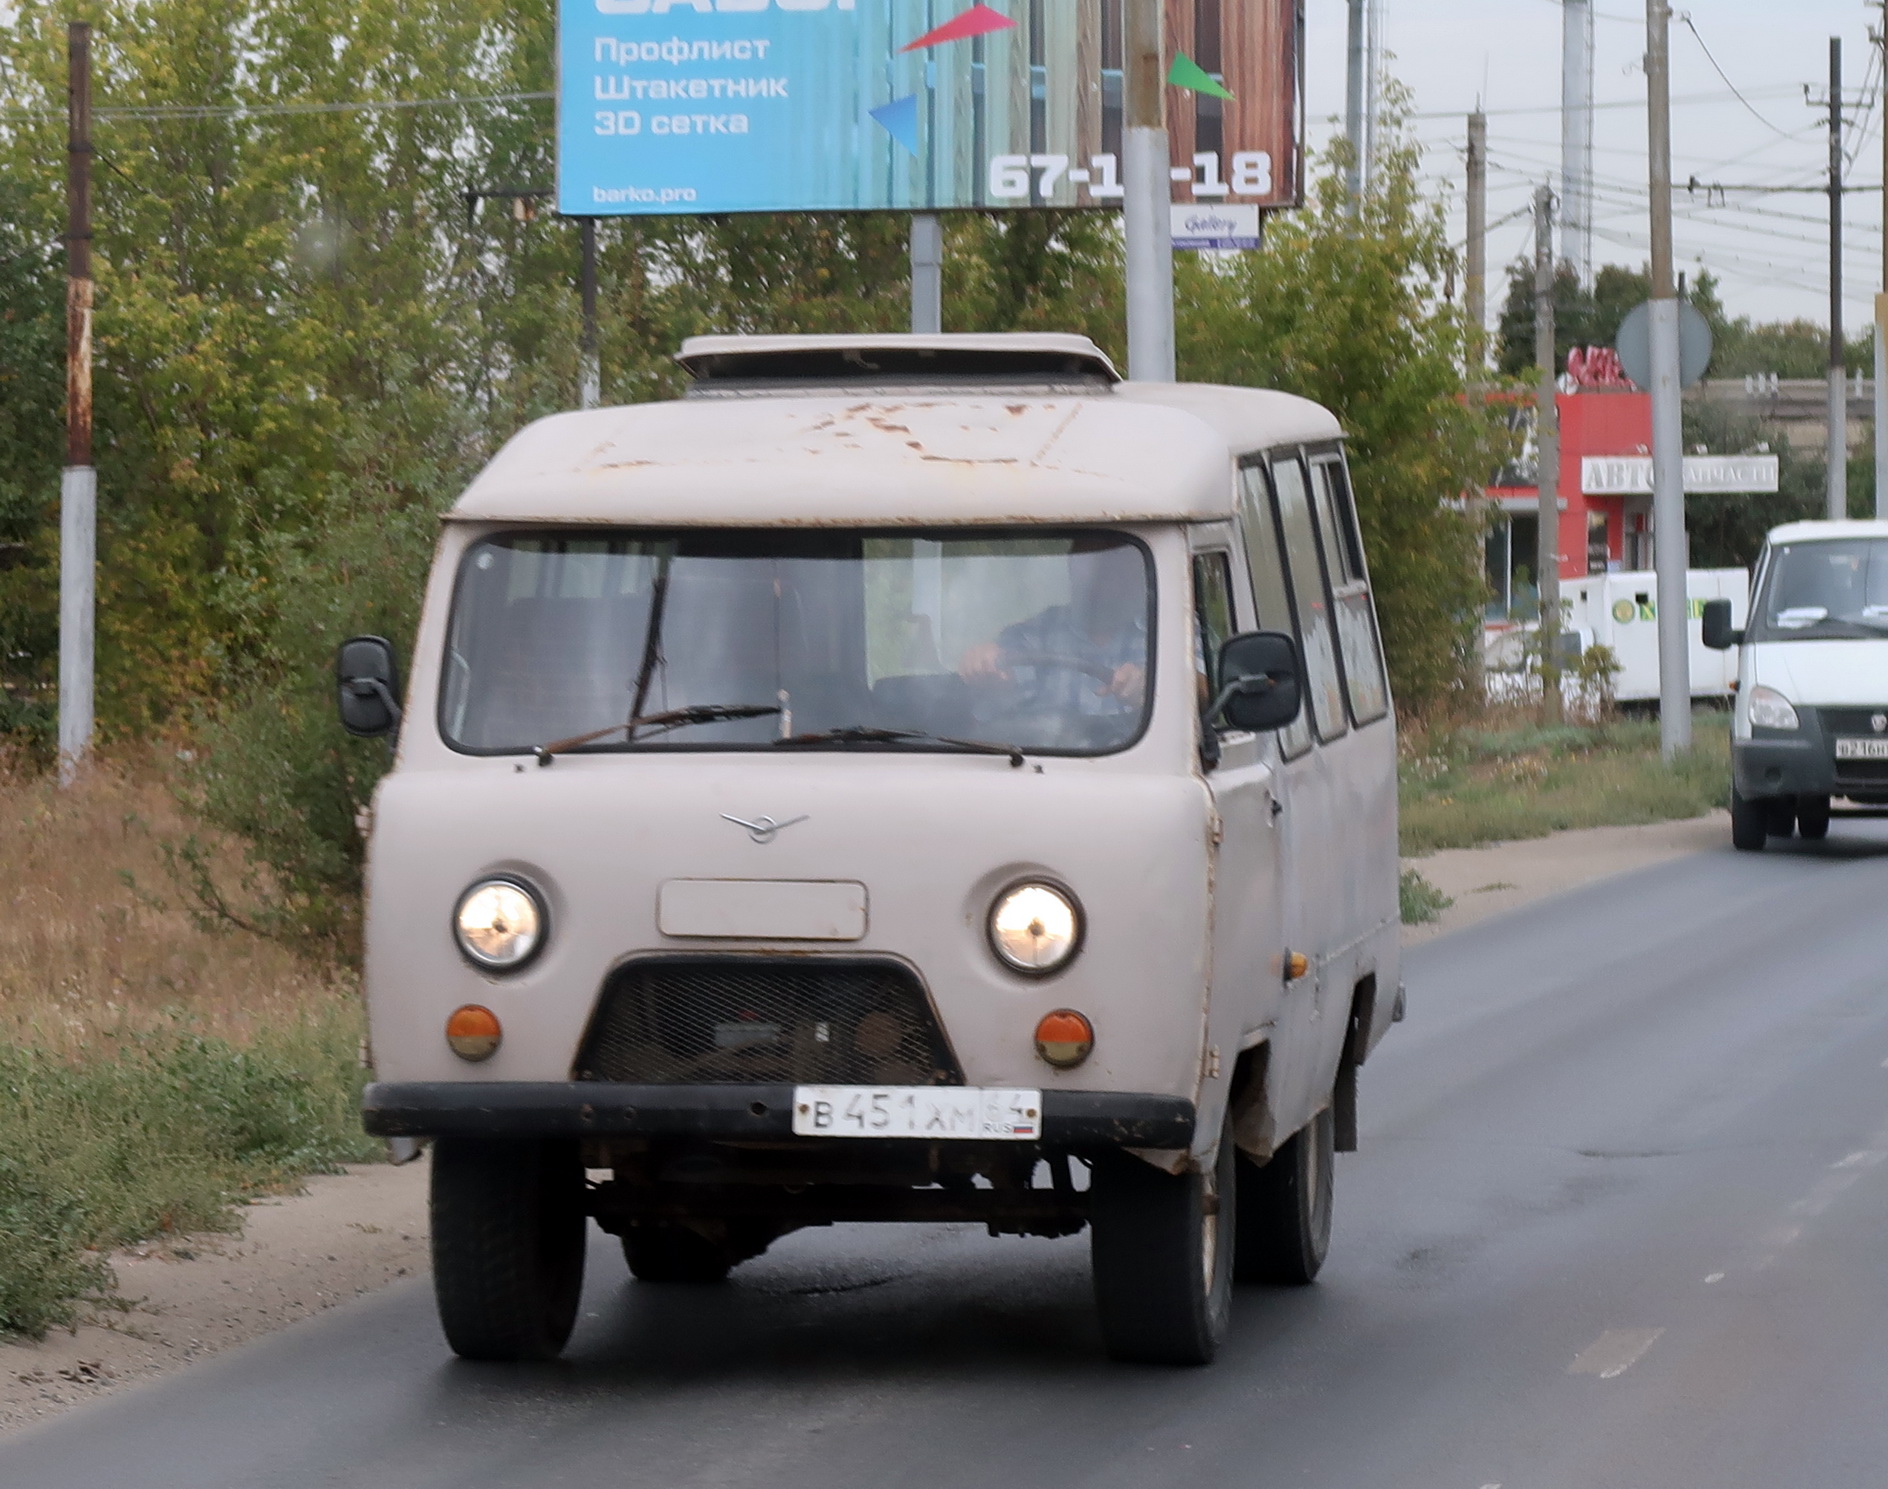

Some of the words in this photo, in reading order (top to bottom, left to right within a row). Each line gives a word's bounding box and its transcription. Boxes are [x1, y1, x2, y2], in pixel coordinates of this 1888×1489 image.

[594, 36, 771, 66] Профлист
[594, 74, 788, 100] Штакетник
[594, 110, 641, 136] 3D
[651, 112, 749, 134] сетка
[990, 151, 1272, 198] 67-1-18
[592, 184, 697, 204] barko.pro
[984, 1122, 1013, 1134] RUS
